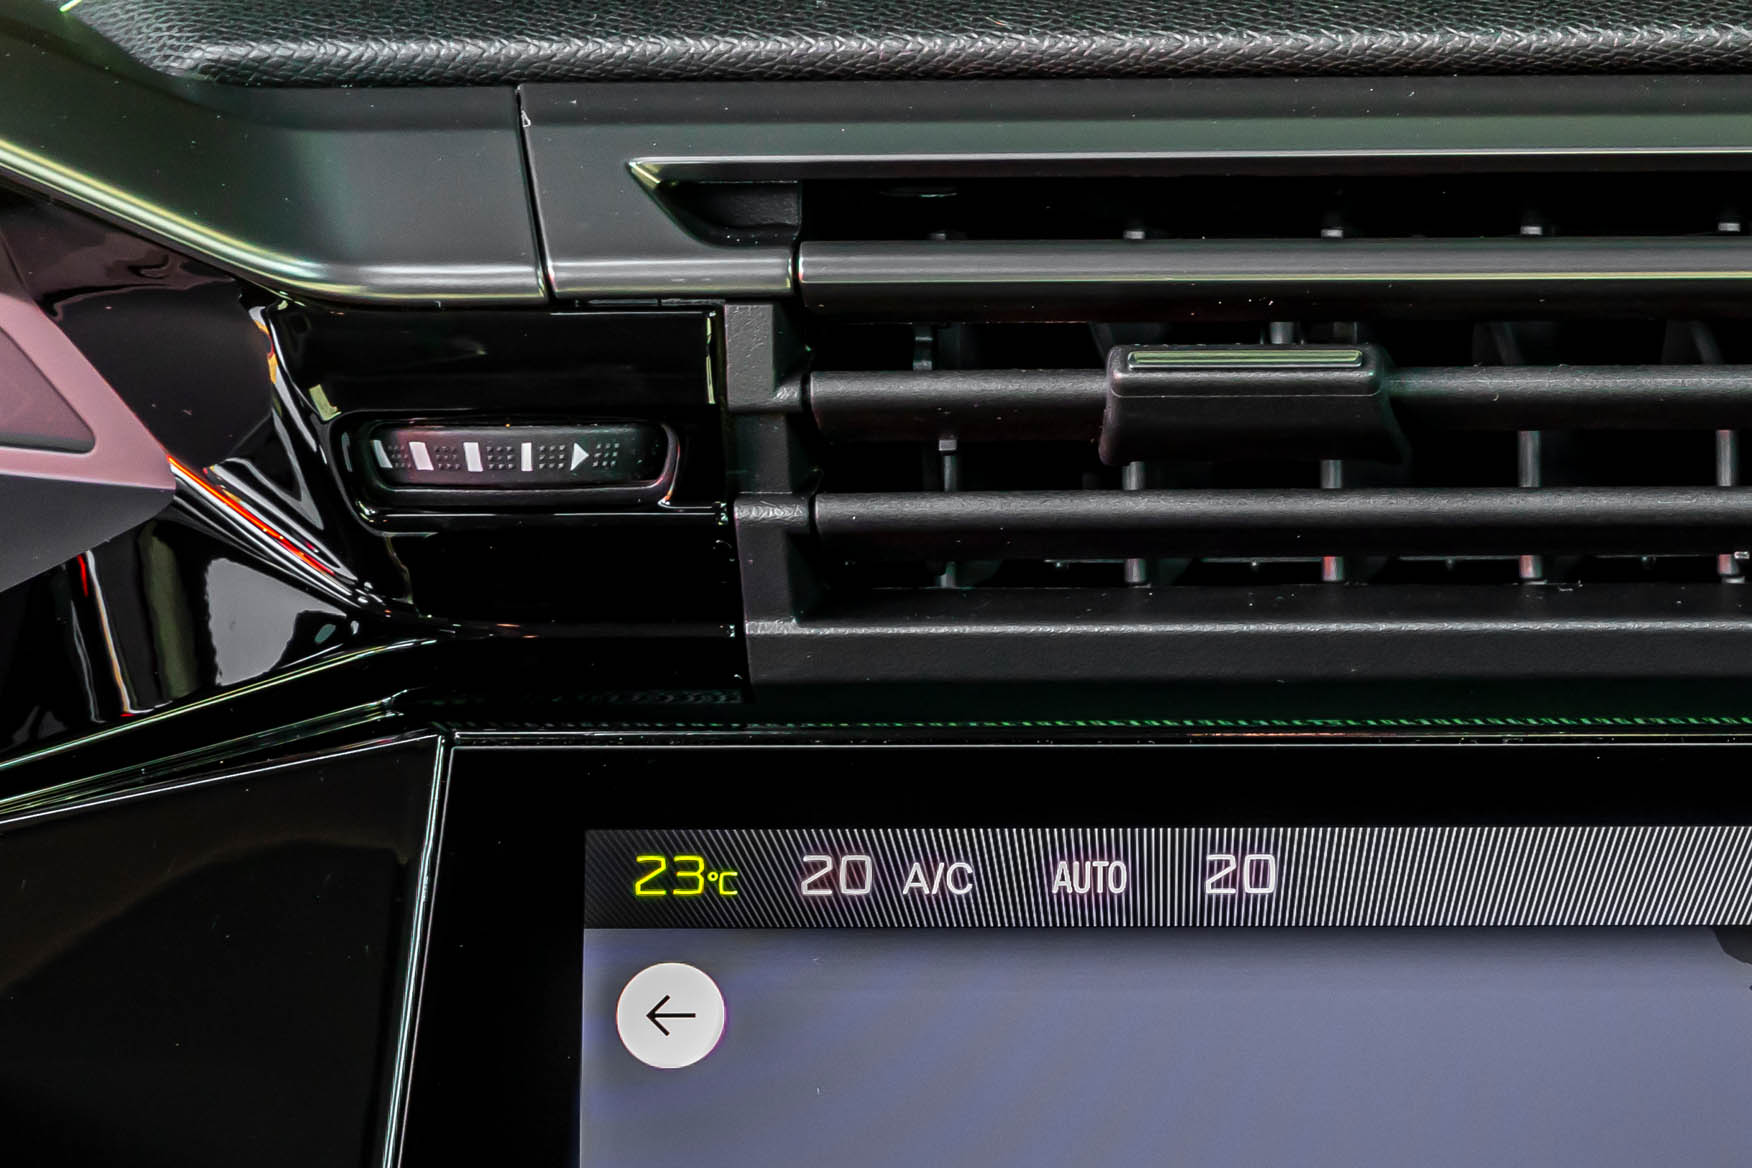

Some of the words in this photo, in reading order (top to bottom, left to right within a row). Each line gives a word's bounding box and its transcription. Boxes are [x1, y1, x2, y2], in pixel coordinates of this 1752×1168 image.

[801, 855, 873, 895] 20
[903, 861, 974, 895] A/C
[1052, 861, 1128, 894] AUTO
[1205, 854, 1276, 894] 20
